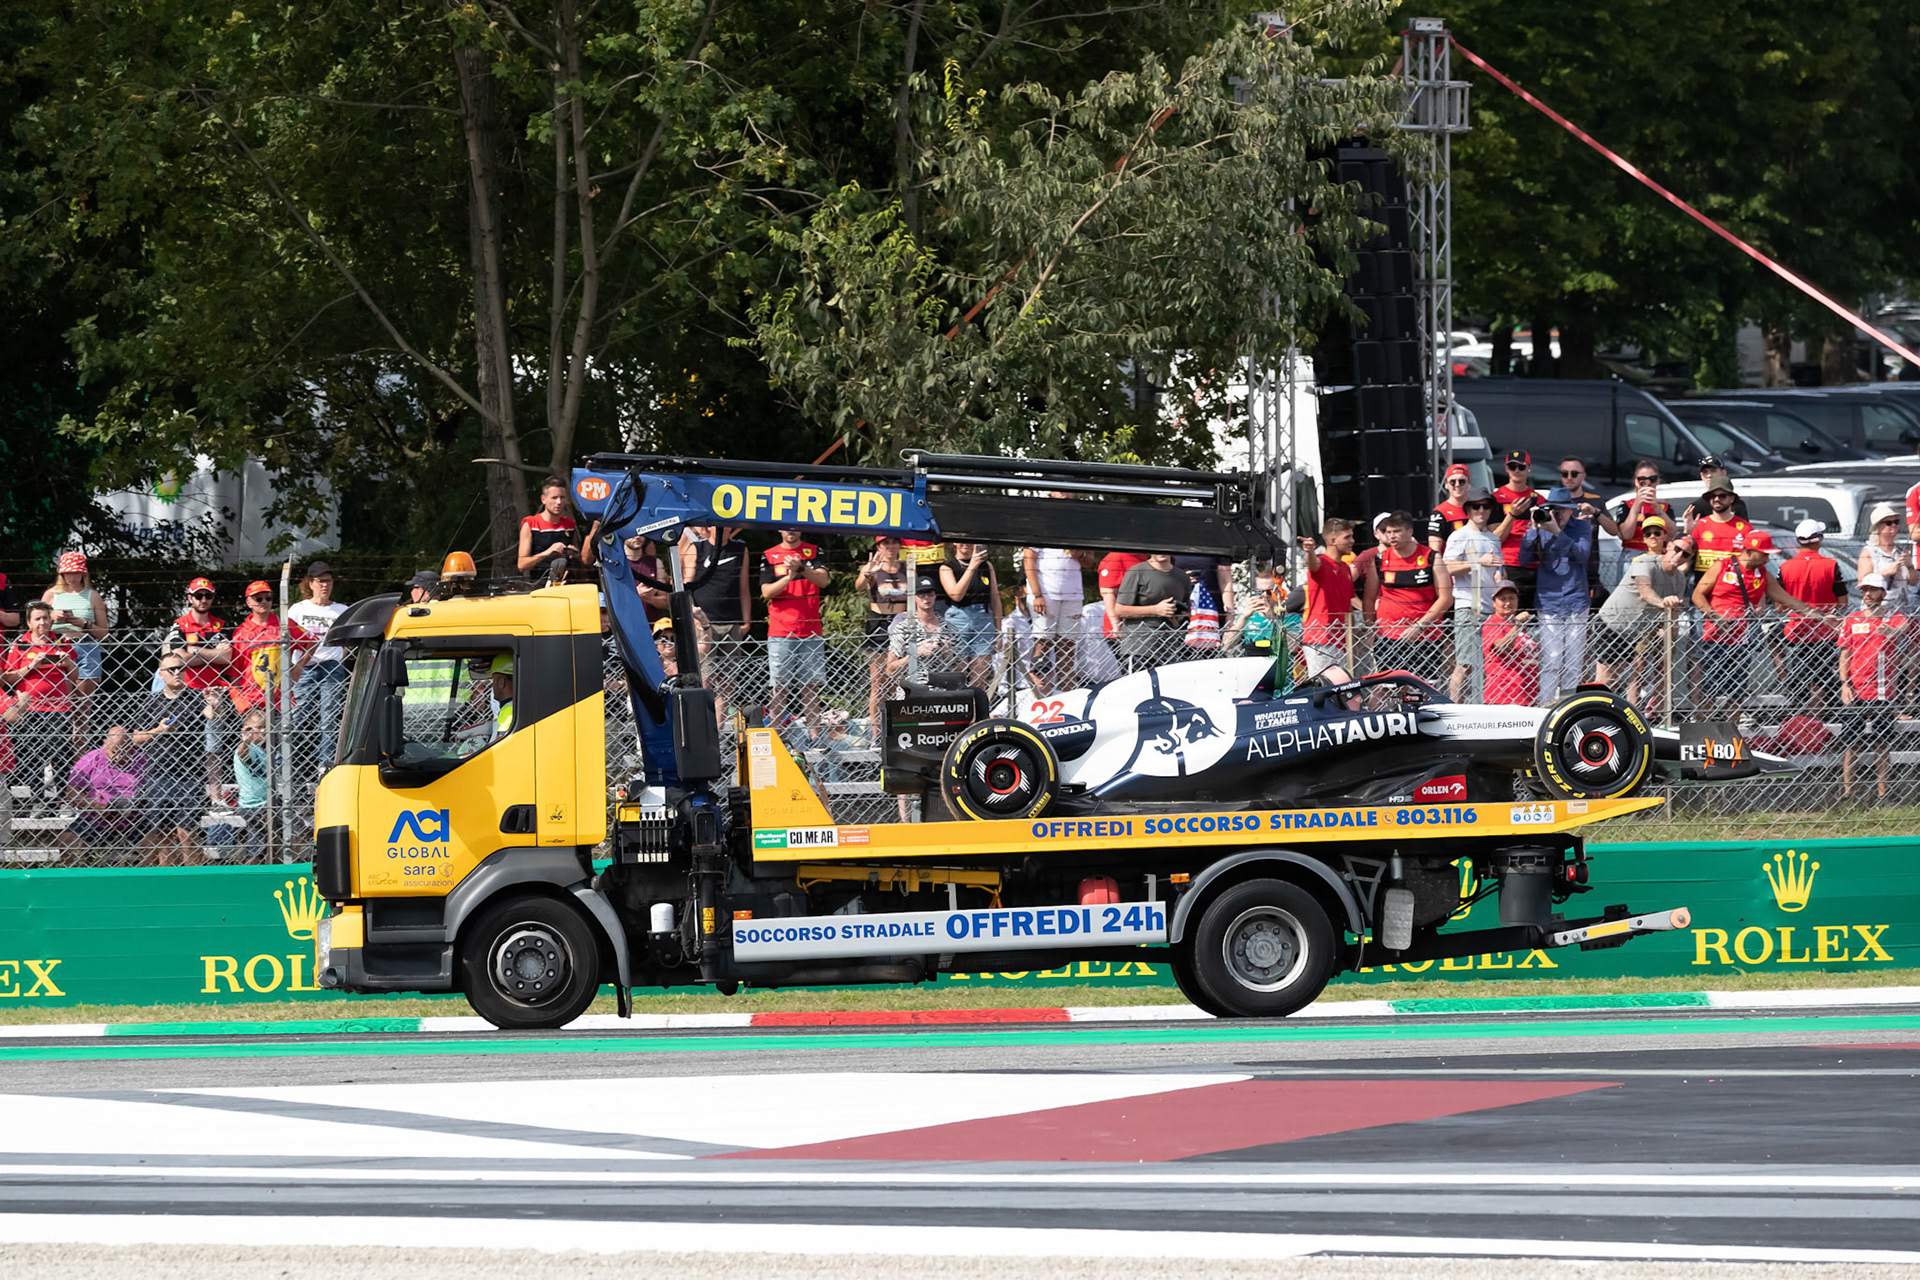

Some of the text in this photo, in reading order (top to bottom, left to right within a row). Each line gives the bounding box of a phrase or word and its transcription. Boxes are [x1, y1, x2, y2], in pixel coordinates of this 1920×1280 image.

[580, 481, 607, 499] PM
[711, 483, 902, 528] OFFREDI
[900, 704, 969, 715] ALPHATAURI
[1030, 700, 1065, 724] 22
[1254, 709, 1298, 721] WHATEVER
[1623, 706, 1647, 735] PIRELLI
[954, 727, 988, 764] ZERO
[1246, 713, 1418, 761] ALPHATAURI
[1680, 736, 1744, 769] FLEXBOX
[1543, 750, 1573, 793] ZERO
[1421, 785, 1449, 795] ORLEN
[387, 809, 450, 843] ACI
[1032, 807, 1478, 839] OFFREDI SOCCORSO STRADALE 803.116
[387, 847, 450, 859] GLOBAL
[403, 865, 436, 876] sara
[403, 878, 455, 887] assicurazioni
[735, 906, 1164, 944] SOCCORSO STRADALE OFFREDI 24h
[1690, 924, 1894, 965] ROLEX
[200, 954, 321, 994] ROL
